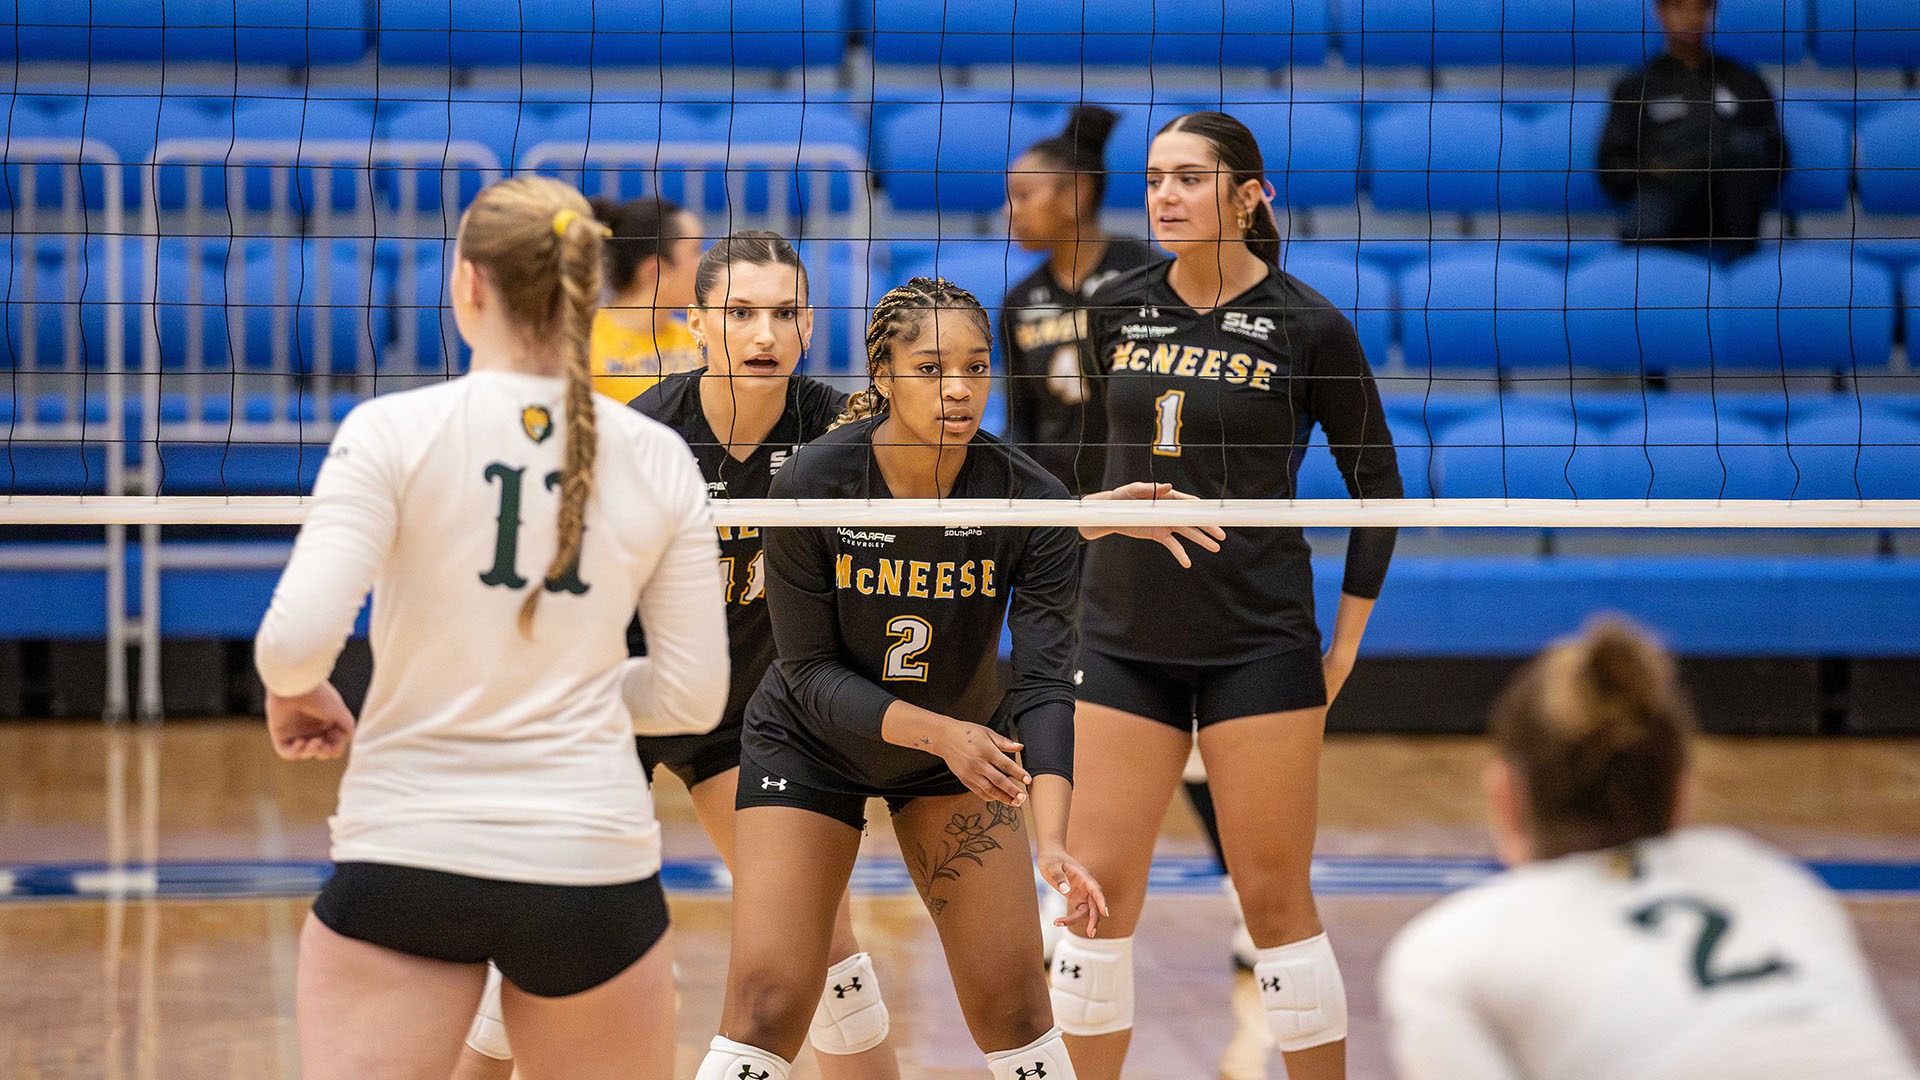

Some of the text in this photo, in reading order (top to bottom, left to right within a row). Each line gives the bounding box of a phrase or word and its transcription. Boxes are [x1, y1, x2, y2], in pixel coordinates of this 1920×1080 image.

[1223, 311, 1277, 334] SLC
[1112, 341, 1277, 391] McNEESE
[1152, 389, 1186, 457] 1
[836, 527, 897, 543] NAVARRE
[836, 553, 996, 599] McNEESE
[882, 615, 933, 682] 2
[1628, 895, 1797, 988] 2
